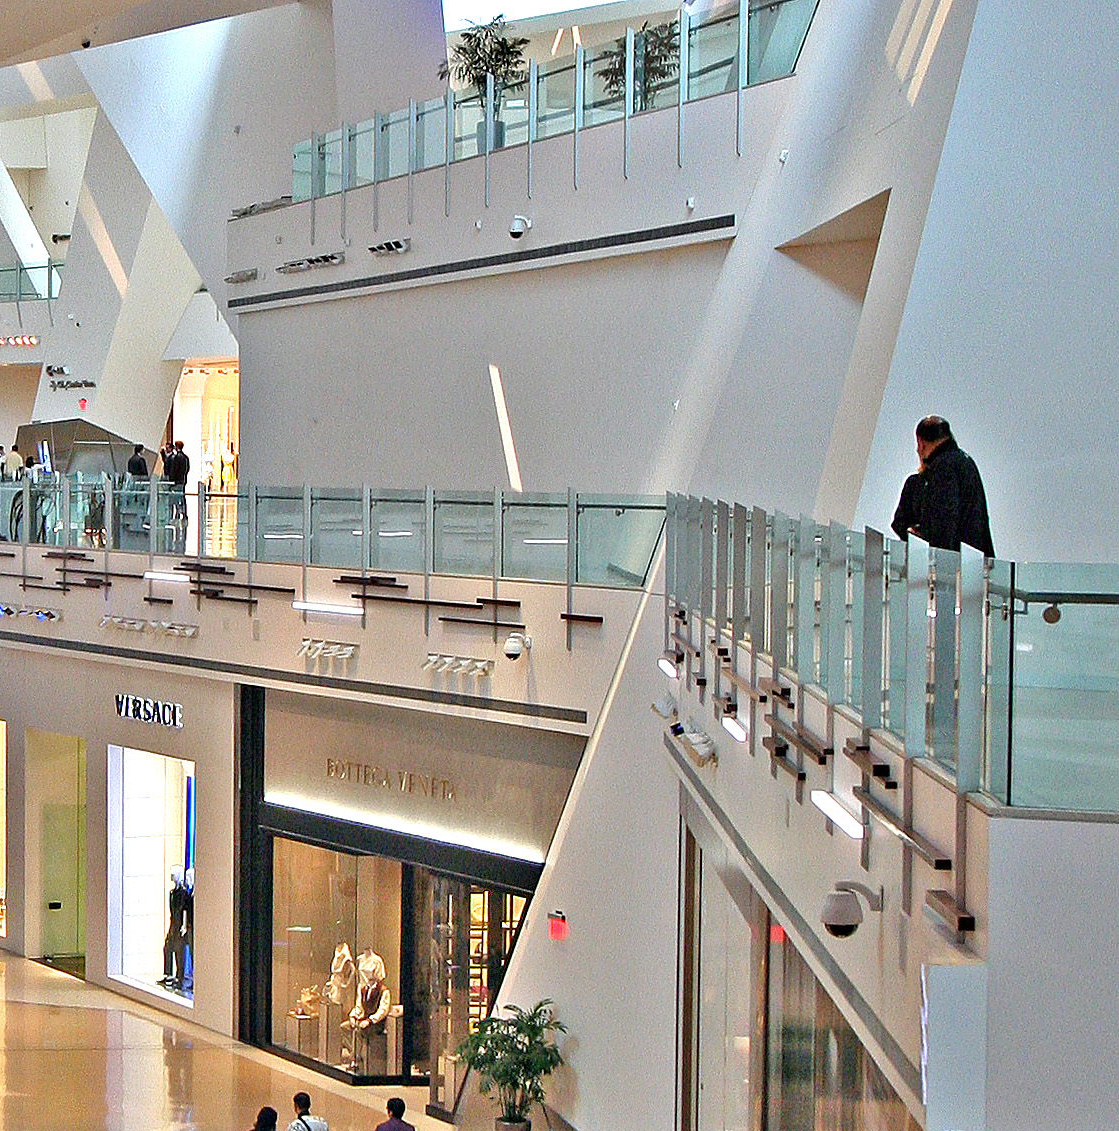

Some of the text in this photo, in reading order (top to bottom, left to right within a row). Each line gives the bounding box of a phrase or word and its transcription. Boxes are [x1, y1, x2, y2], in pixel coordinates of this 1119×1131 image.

[115, 694, 184, 729] VERSACE
[326, 758, 458, 803] BOTTEGA VENETA
